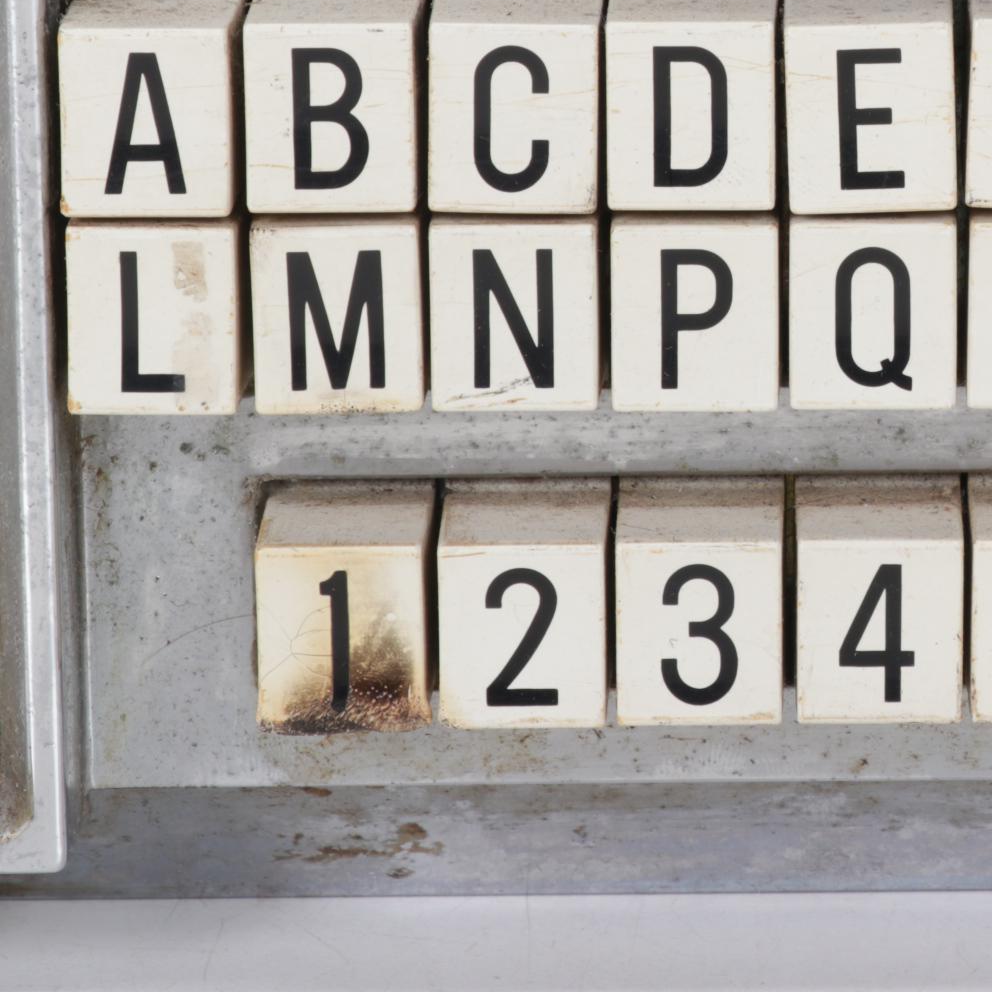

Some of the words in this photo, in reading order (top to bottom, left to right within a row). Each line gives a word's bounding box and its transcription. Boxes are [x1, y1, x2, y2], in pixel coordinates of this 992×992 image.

[104, 52, 187, 195] A
[291, 47, 370, 190] B
[473, 45, 550, 193] C
[652, 46, 728, 188] D
[836, 48, 905, 190] E
[119, 251, 186, 393] L
[286, 250, 386, 391] M
[472, 248, 555, 389] N
[660, 248, 733, 390] P
[835, 246, 913, 391] Q
[318, 570, 350, 711] 1
[485, 567, 559, 707] 2
[661, 563, 739, 706] 3
[839, 564, 915, 703] 4
